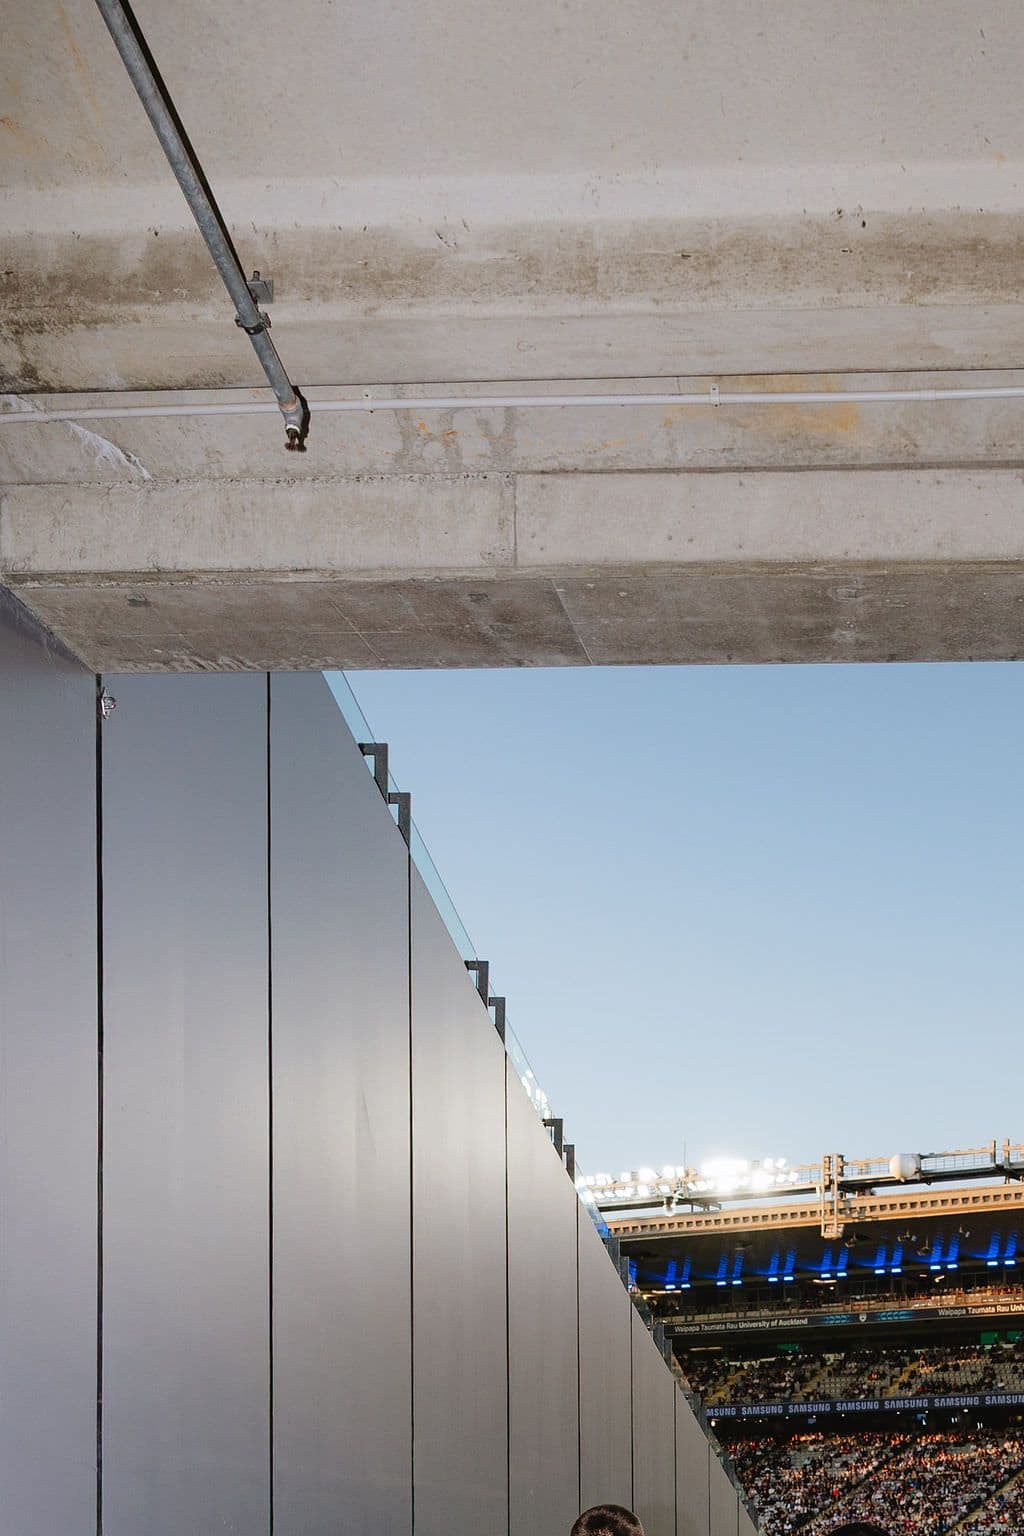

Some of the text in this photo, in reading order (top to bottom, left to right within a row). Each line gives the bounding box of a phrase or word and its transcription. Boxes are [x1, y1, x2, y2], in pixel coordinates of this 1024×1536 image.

[701, 1323, 726, 1331] Taumata
[738, 1321, 770, 1329] University
[771, 1319, 779, 1327] of
[778, 1317, 808, 1326] Auckland
[706, 1407, 737, 1416] MSUNG
[741, 1404, 783, 1415] SAMSUNG
[788, 1403, 831, 1413] SAMSUNG
[836, 1400, 879, 1411] SAMSUNG
[884, 1398, 929, 1409] SAMSUNG
[934, 1396, 980, 1407] SAMSUNG
